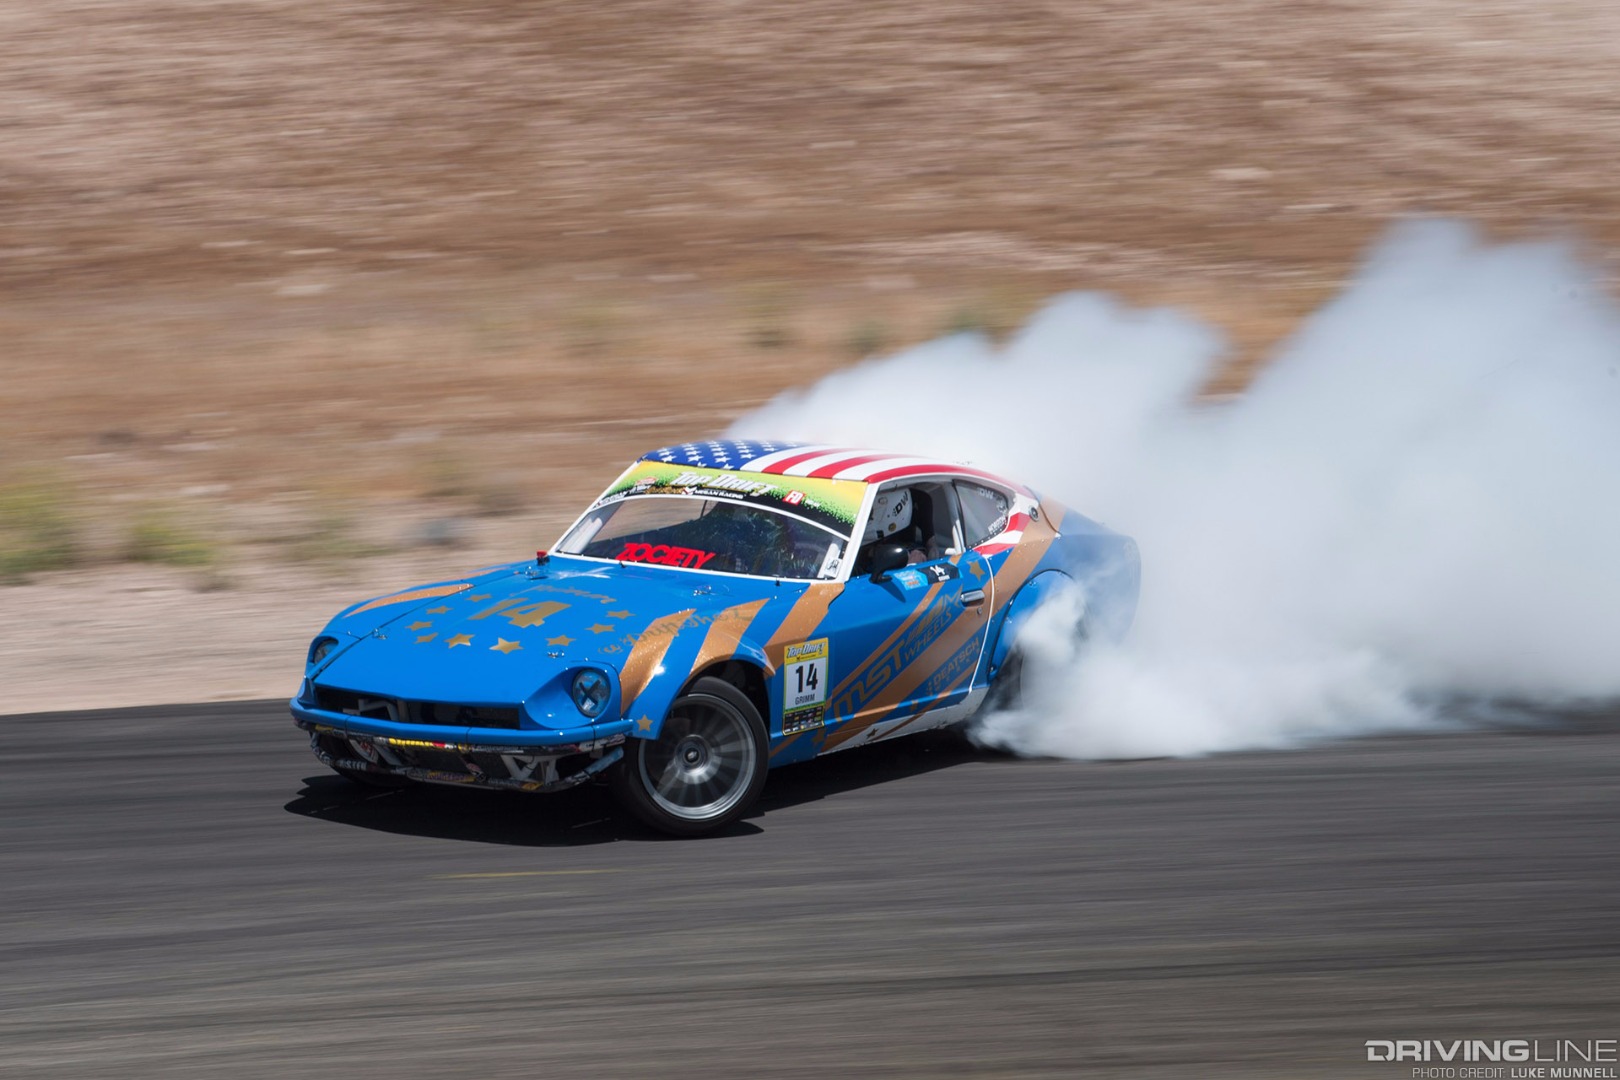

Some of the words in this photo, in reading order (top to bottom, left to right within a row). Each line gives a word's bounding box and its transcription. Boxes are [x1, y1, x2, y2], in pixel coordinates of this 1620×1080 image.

[615, 543, 716, 569] ZOCIETY
[467, 597, 572, 629] 14
[904, 607, 952, 661] WHEELS
[795, 663, 818, 693] 14
[795, 693, 815, 705] GRIMM
